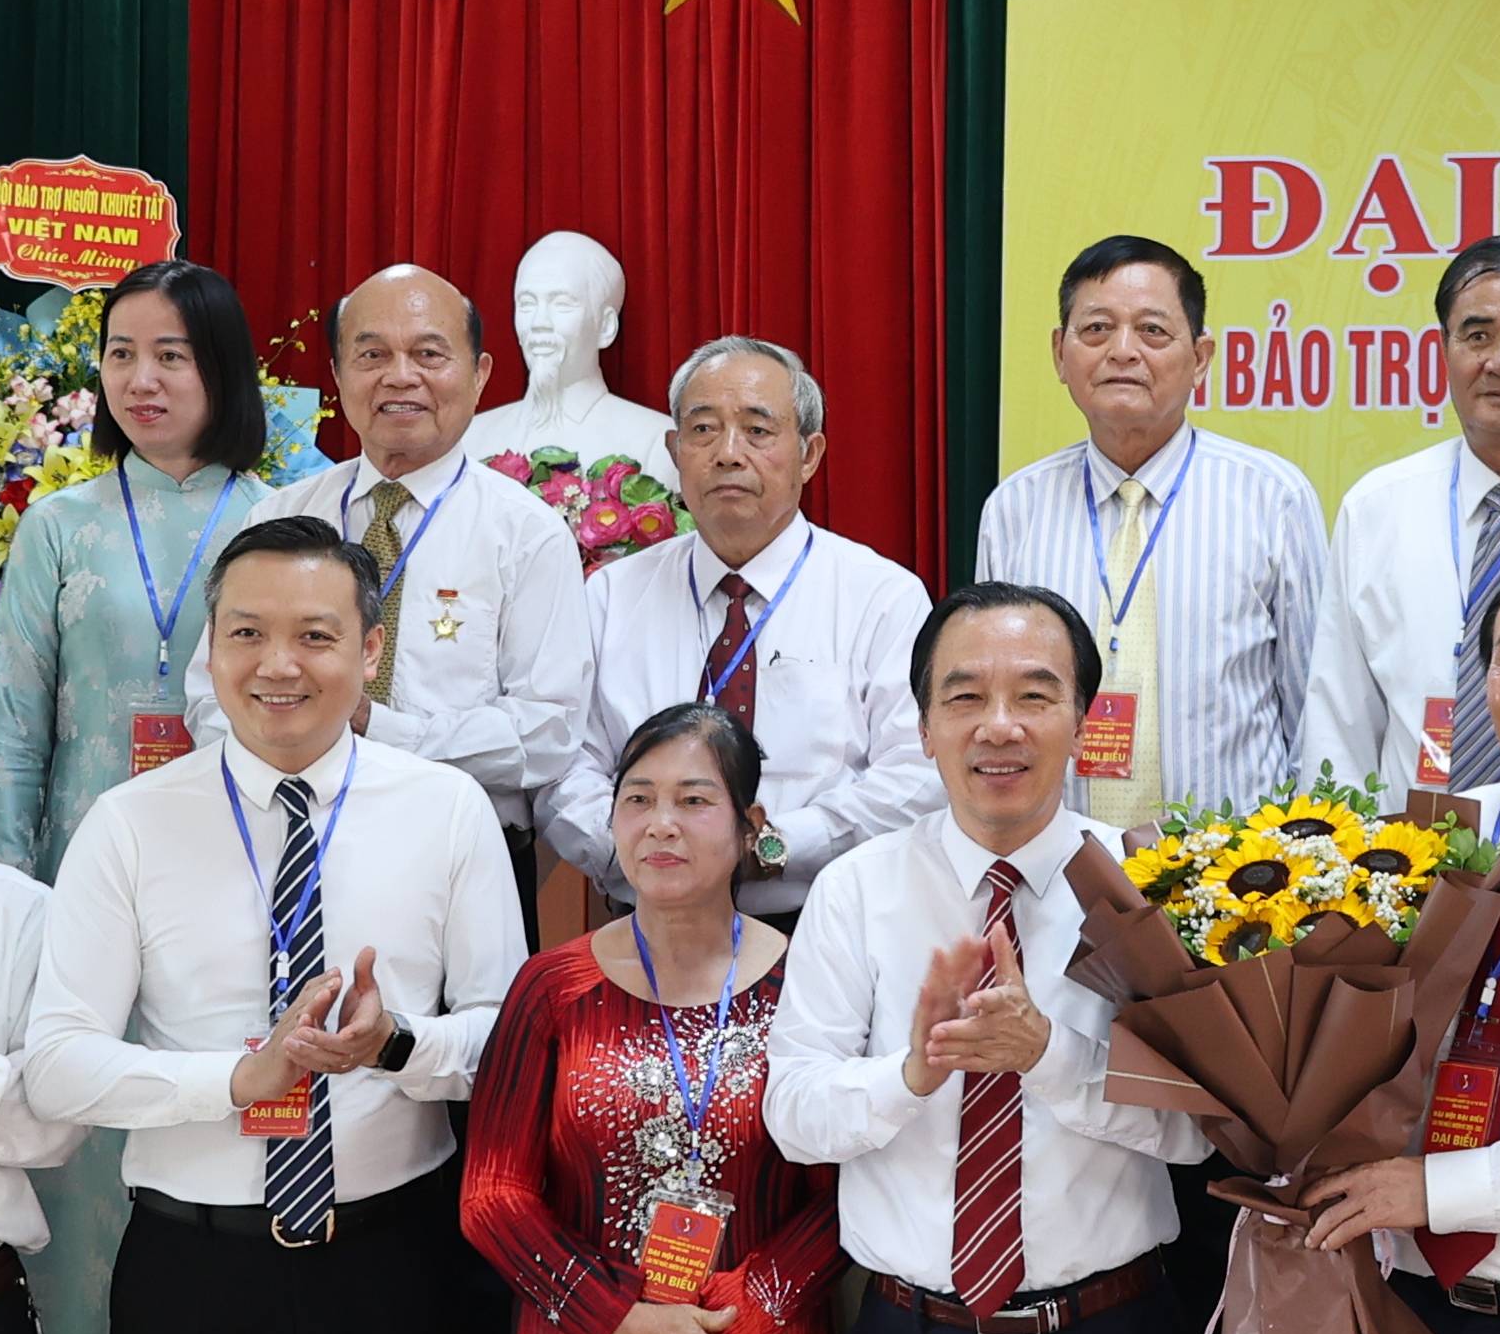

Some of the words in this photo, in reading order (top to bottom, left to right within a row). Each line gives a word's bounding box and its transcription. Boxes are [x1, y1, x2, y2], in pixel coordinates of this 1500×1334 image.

[14, 174, 38, 209] BẢO
[7, 217, 67, 241] VIỆT
[73, 223, 140, 246] NAM
[1226, 303, 1331, 407] BẢO
